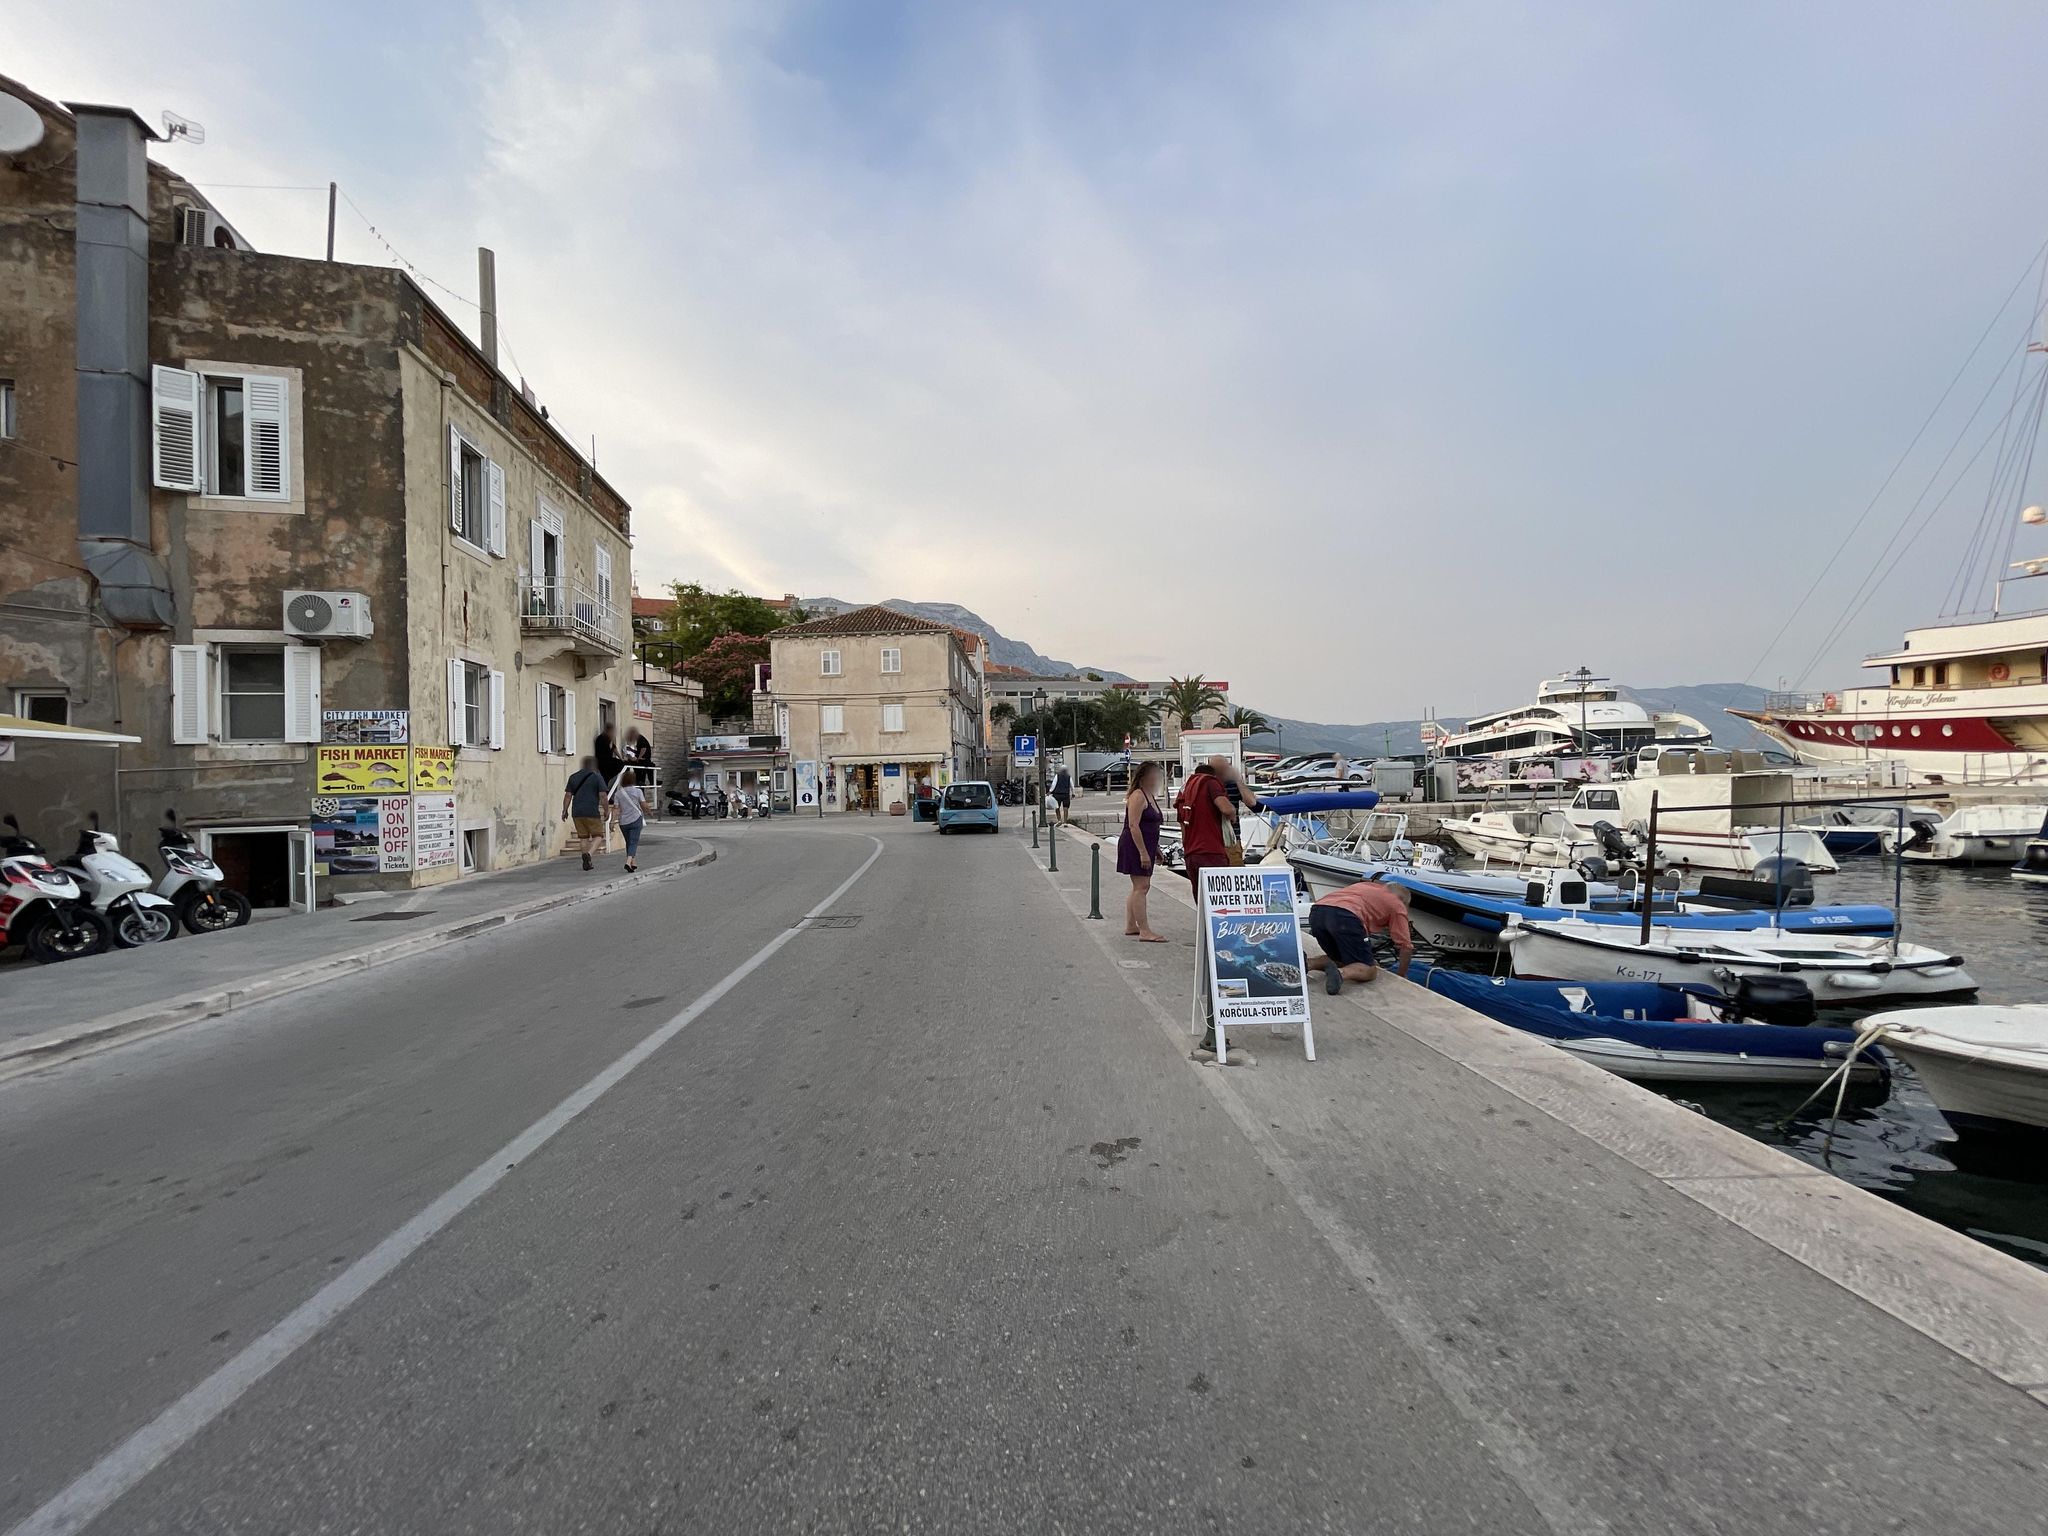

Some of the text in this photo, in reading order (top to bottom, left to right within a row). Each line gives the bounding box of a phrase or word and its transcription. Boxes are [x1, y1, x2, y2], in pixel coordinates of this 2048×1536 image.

[1922, 693, 1957, 707] Jelena
[326, 711, 406, 719] CITY FISH MARKET
[1021, 738, 1030, 750] P
[320, 748, 406, 760] FISH MARKET
[415, 747, 453, 759] FISH MARKET
[345, 784, 365, 792] 10m
[382, 799, 409, 811] HOP
[386, 813, 405, 824] ON
[382, 826, 409, 839] HOP
[384, 840, 408, 853] OFF
[387, 855, 406, 863] Daily
[1207, 874, 1262, 892] MORO BEACH
[1546, 870, 1556, 903] TAXI
[1209, 894, 1264, 906] WATER TAXI
[1243, 907, 1264, 915] TICKET
